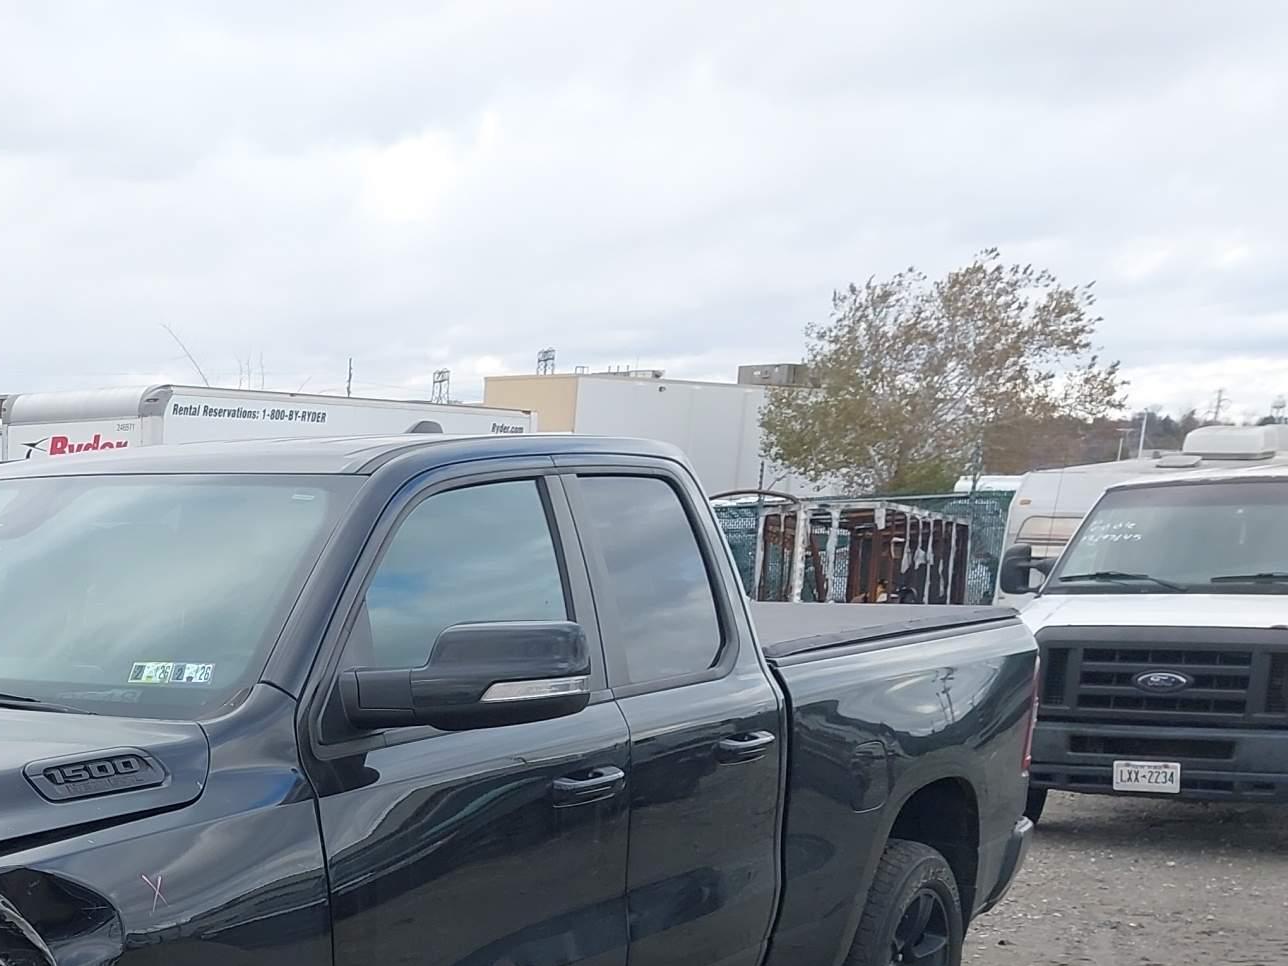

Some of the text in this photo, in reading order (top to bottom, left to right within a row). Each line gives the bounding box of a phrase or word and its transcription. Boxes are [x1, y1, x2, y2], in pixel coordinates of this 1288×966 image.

[172, 403, 327, 423] Rental Reservations: 1-800-BY-RYDER
[43, 757, 141, 785] 1500
